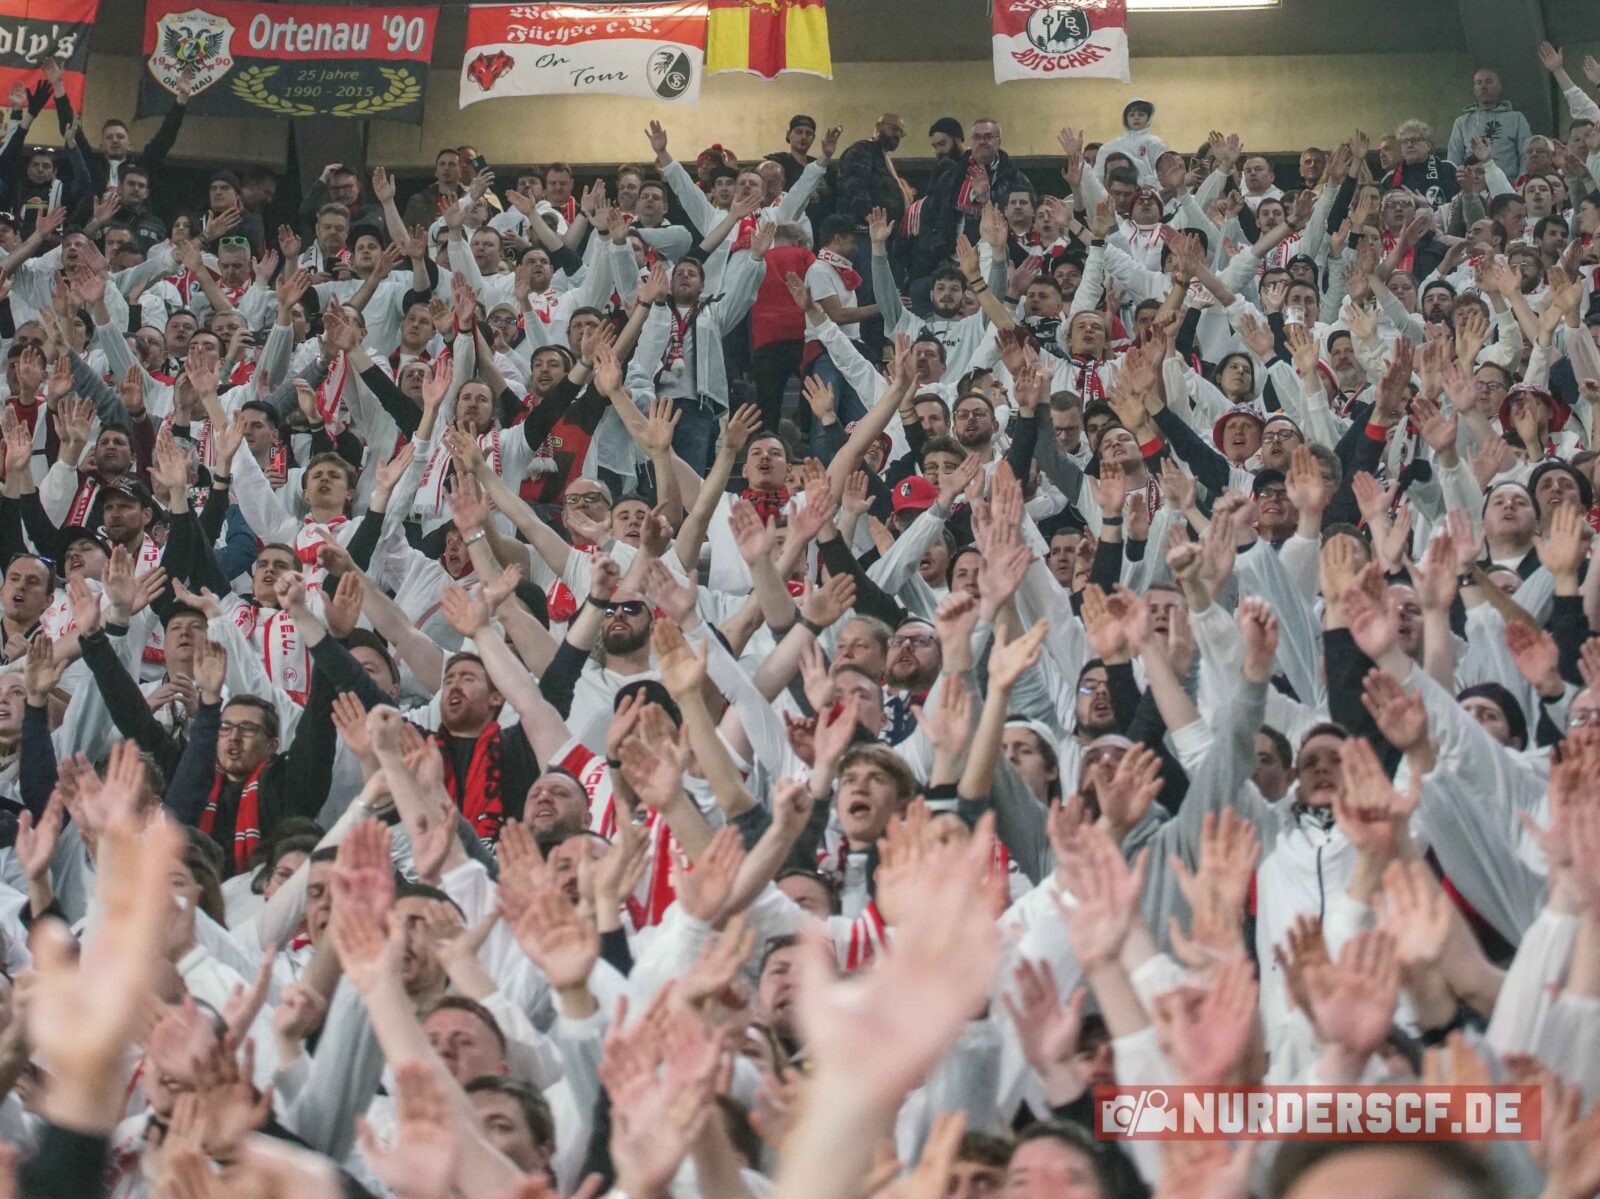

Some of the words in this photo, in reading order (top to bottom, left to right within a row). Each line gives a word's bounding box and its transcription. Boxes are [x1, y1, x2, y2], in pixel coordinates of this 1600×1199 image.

[248, 13, 370, 52] Ortenau
[382, 15, 424, 52] '90
[297, 70, 317, 81] 25
[319, 69, 360, 82] Jahre
[284, 86, 321, 98] 1990
[335, 86, 375, 98] 2015
